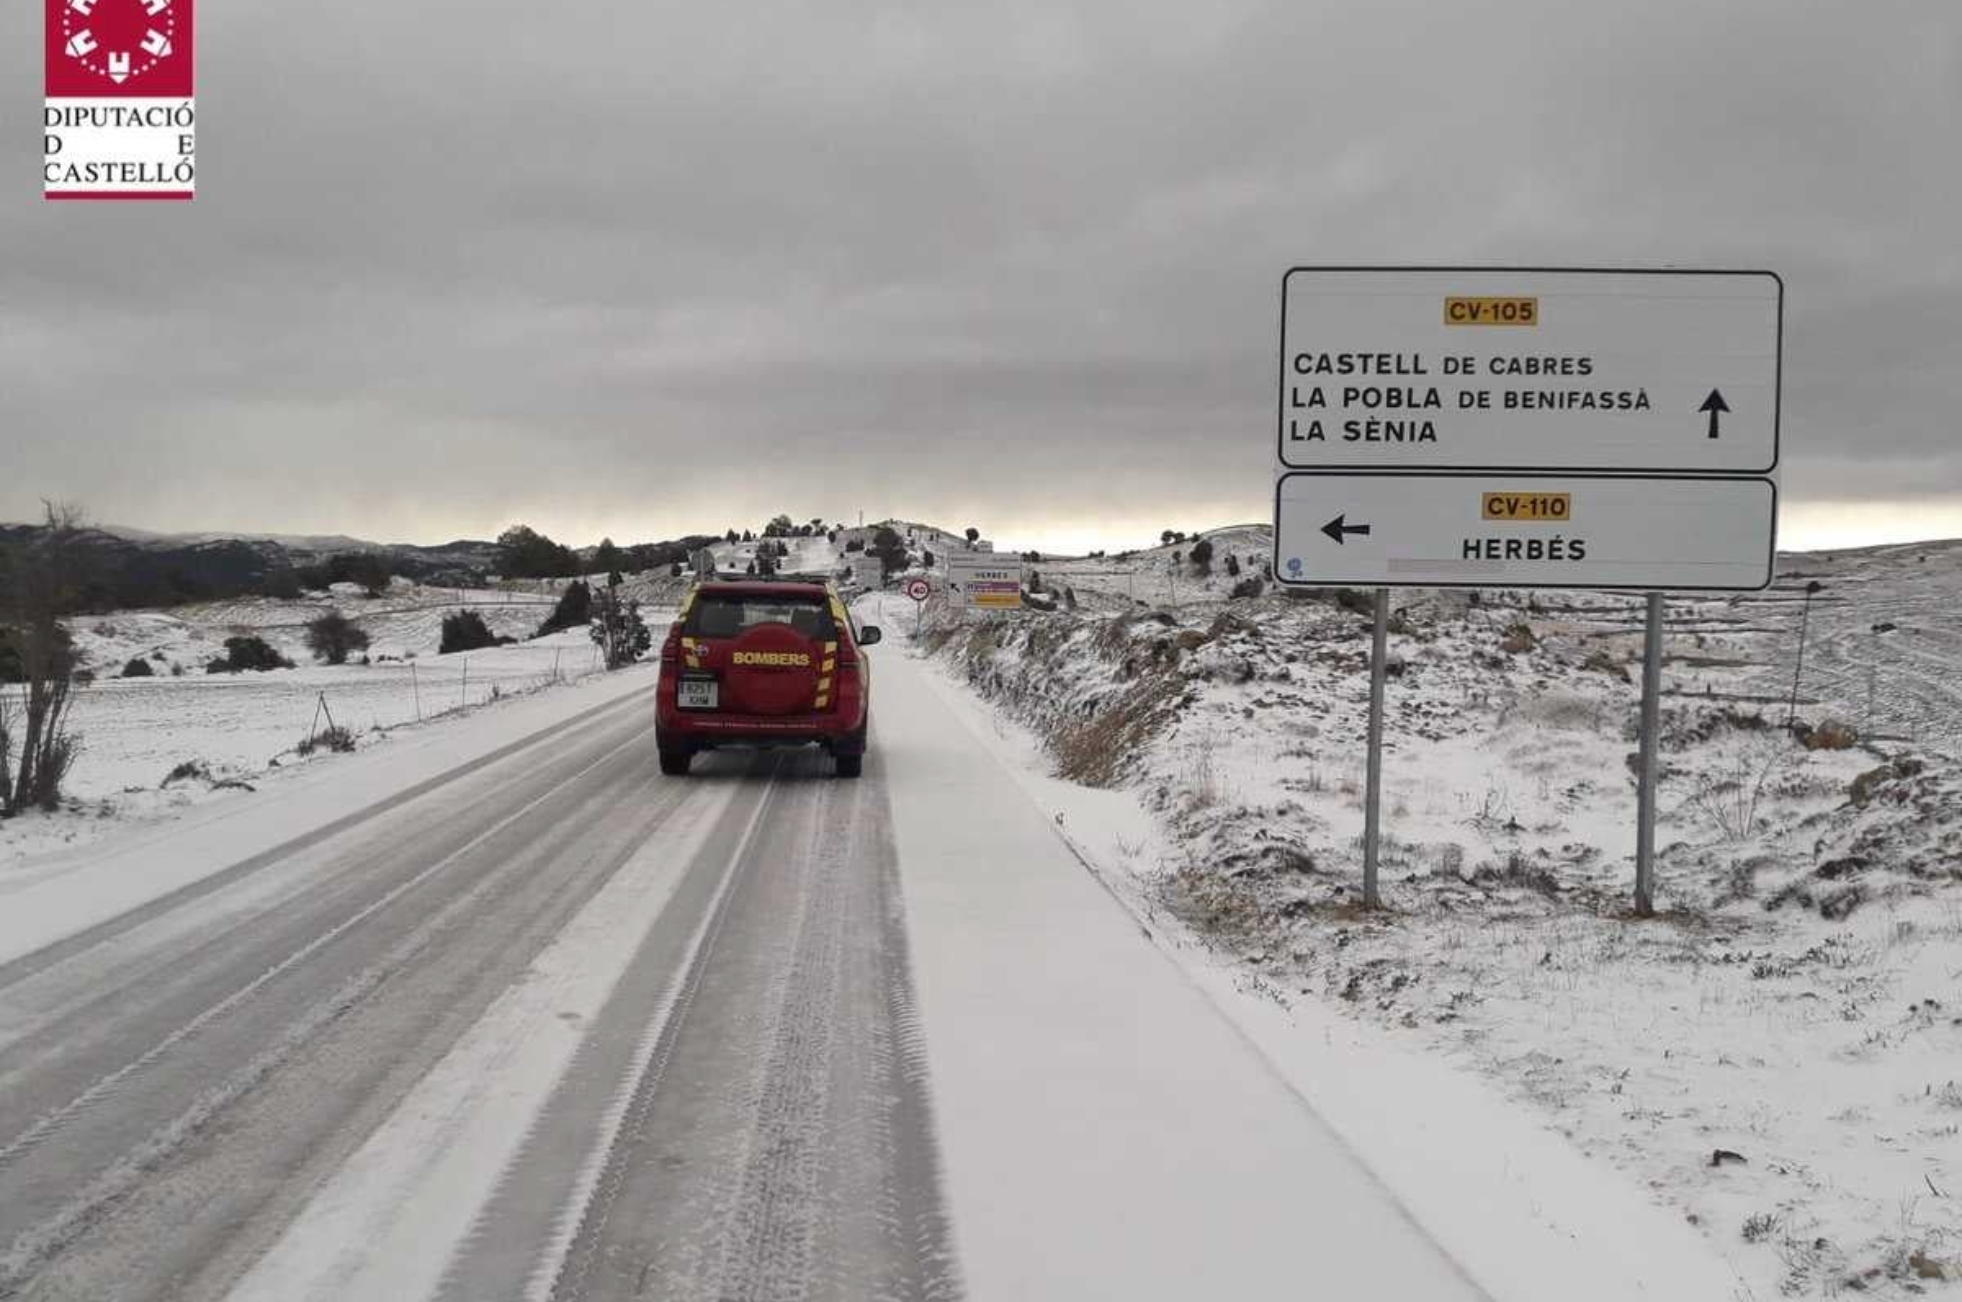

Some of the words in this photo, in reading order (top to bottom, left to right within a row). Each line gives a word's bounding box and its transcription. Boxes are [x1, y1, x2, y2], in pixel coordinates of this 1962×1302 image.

[1449, 302, 1533, 321] CV-105
[1293, 352, 1428, 375] CASTELL
[1443, 356, 1476, 376] DE
[1488, 356, 1593, 376] CABRES
[1292, 386, 1327, 408] LA
[1343, 386, 1442, 409] POBLA
[1458, 390, 1491, 409] DE
[1503, 387, 1651, 410] BENIFASSÀ
[1290, 420, 1326, 442] LA
[1342, 415, 1437, 443] SÈNIA
[1487, 498, 1566, 516] CV-110
[1462, 534, 1586, 561] HERBÉS
[733, 652, 810, 666] BOMBERS
